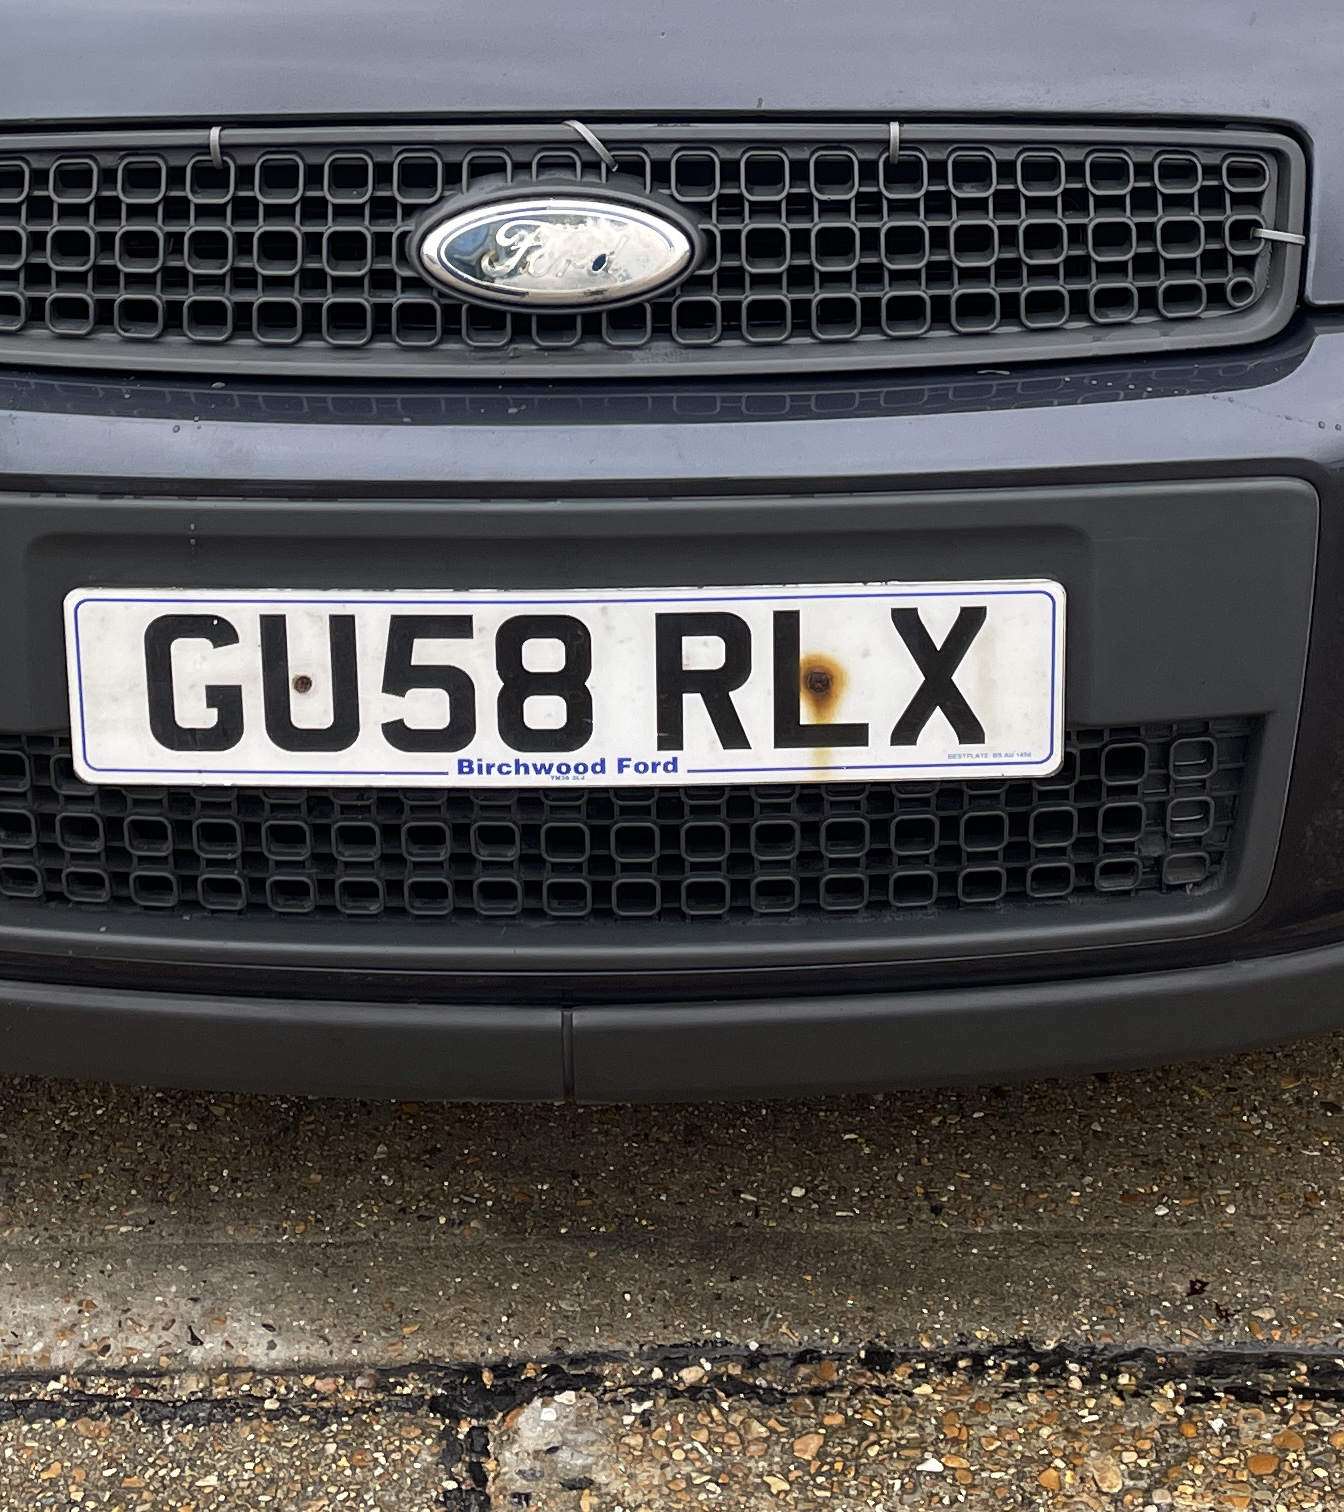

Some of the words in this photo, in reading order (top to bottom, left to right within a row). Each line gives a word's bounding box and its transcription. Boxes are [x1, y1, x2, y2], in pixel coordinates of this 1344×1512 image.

[143, 613, 594, 753] GU58
[655, 606, 988, 751] RLX
[457, 757, 606, 776] Birchwood
[617, 756, 678, 774] Ford
